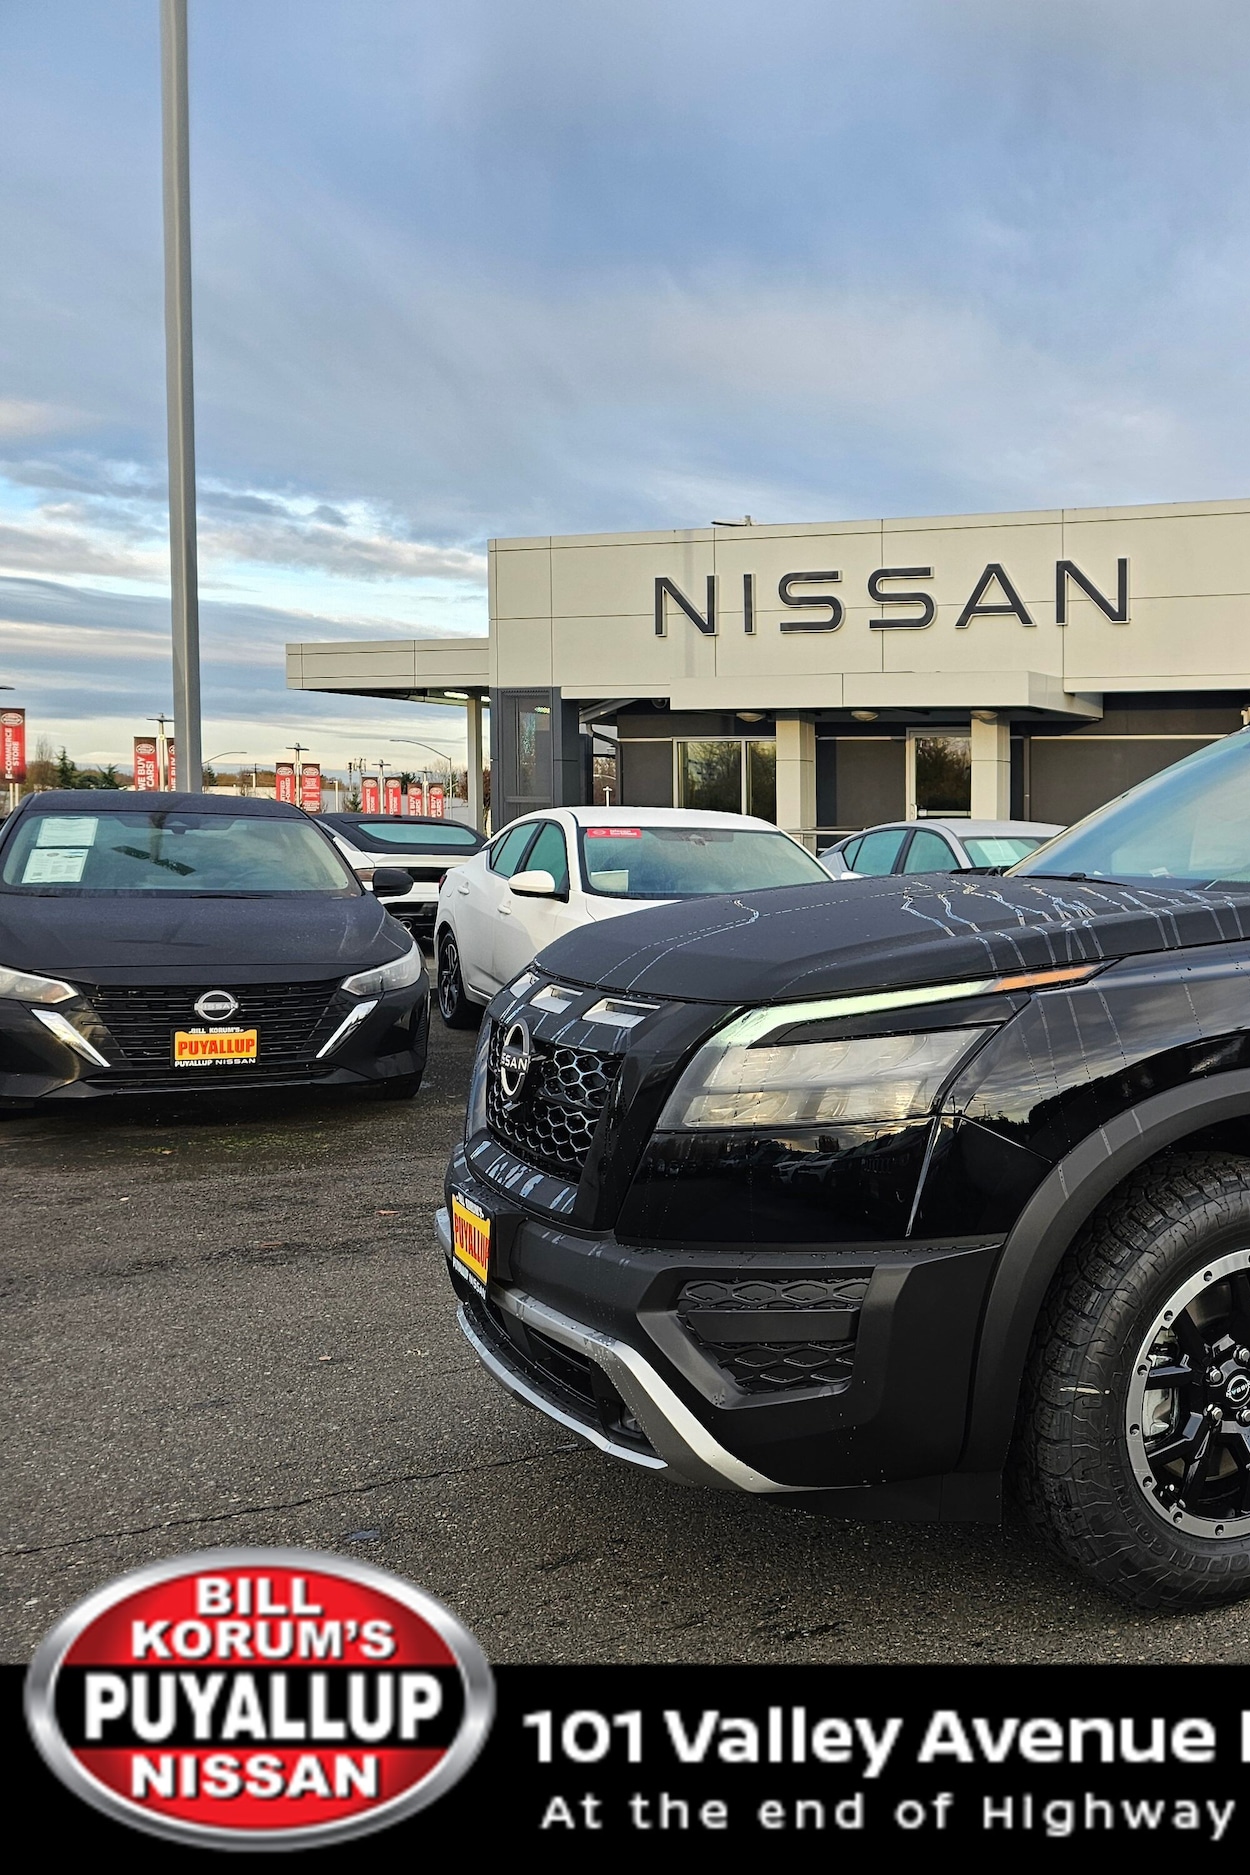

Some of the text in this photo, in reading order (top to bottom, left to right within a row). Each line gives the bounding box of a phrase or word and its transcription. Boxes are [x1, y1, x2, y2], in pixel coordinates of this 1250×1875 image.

[654, 557, 1131, 638] NISSAN
[137, 756, 146, 775] BUY
[146, 761, 155, 788] CARS!
[137, 776, 146, 791] WE
[194, 1002, 239, 1011] NISSAN
[178, 1039, 255, 1056] PUYALLUP
[501, 1052, 528, 1071] SSAN
